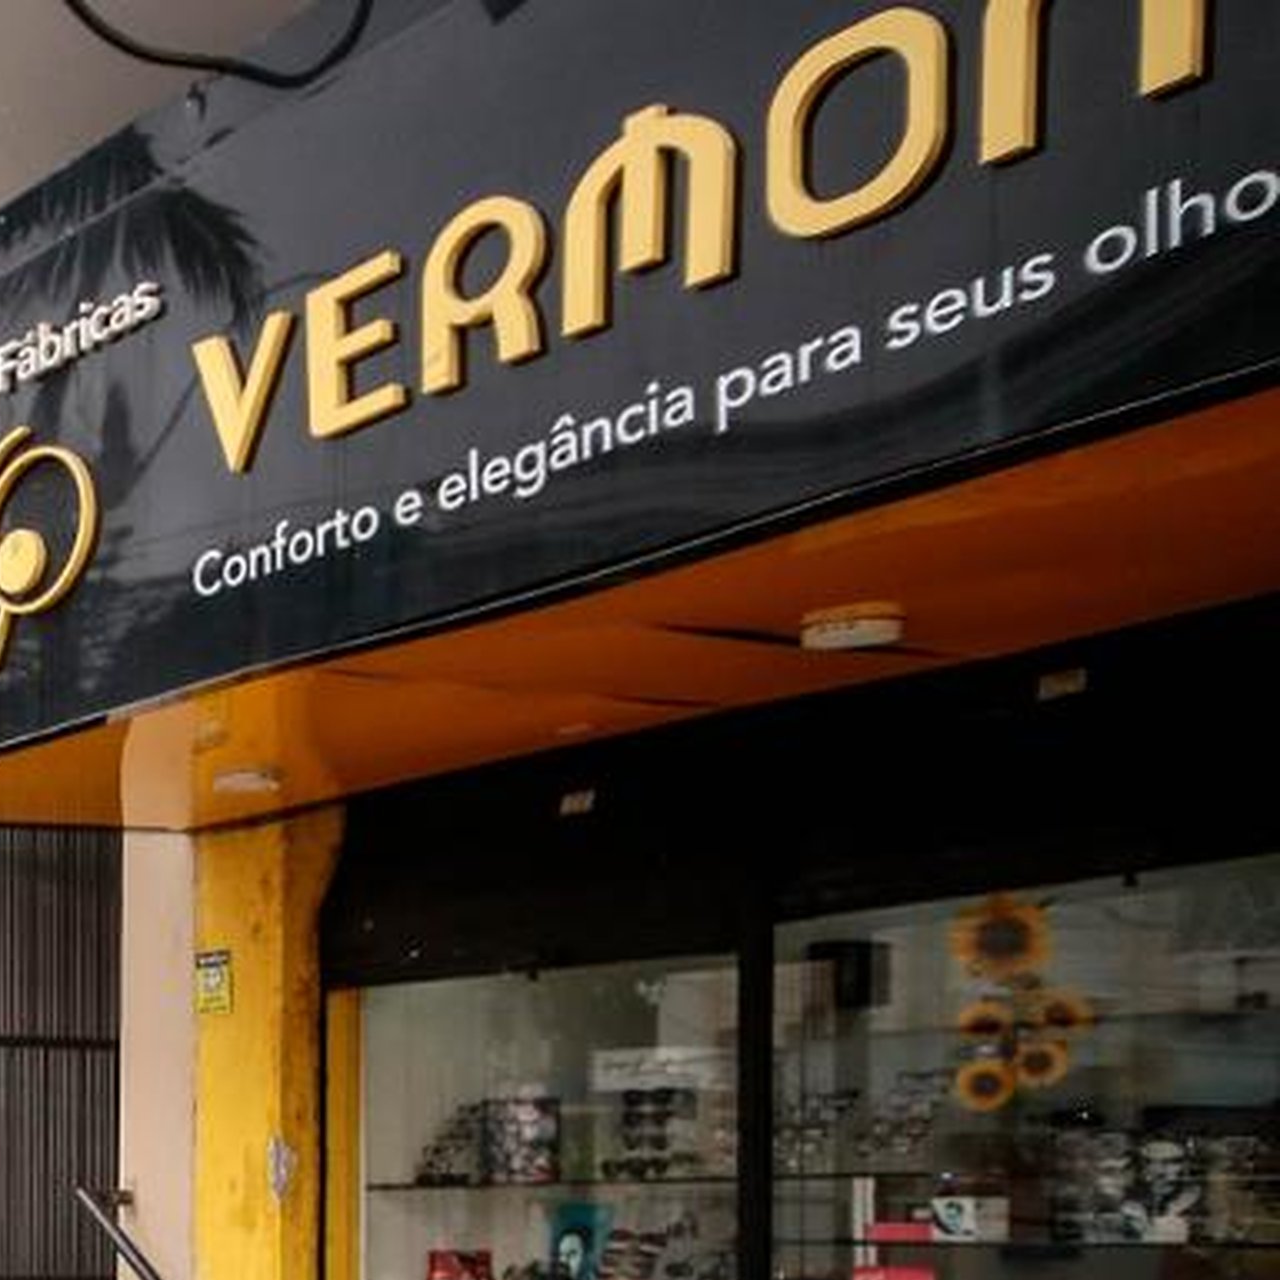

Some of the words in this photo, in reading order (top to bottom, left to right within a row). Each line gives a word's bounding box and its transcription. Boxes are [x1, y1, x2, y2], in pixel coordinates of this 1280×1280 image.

[192, 504, 380, 596] Conforto
[394, 490, 424, 526] e
[437, 380, 696, 511] elegância
[716, 324, 863, 433] para
[885, 251, 1057, 351] seus
